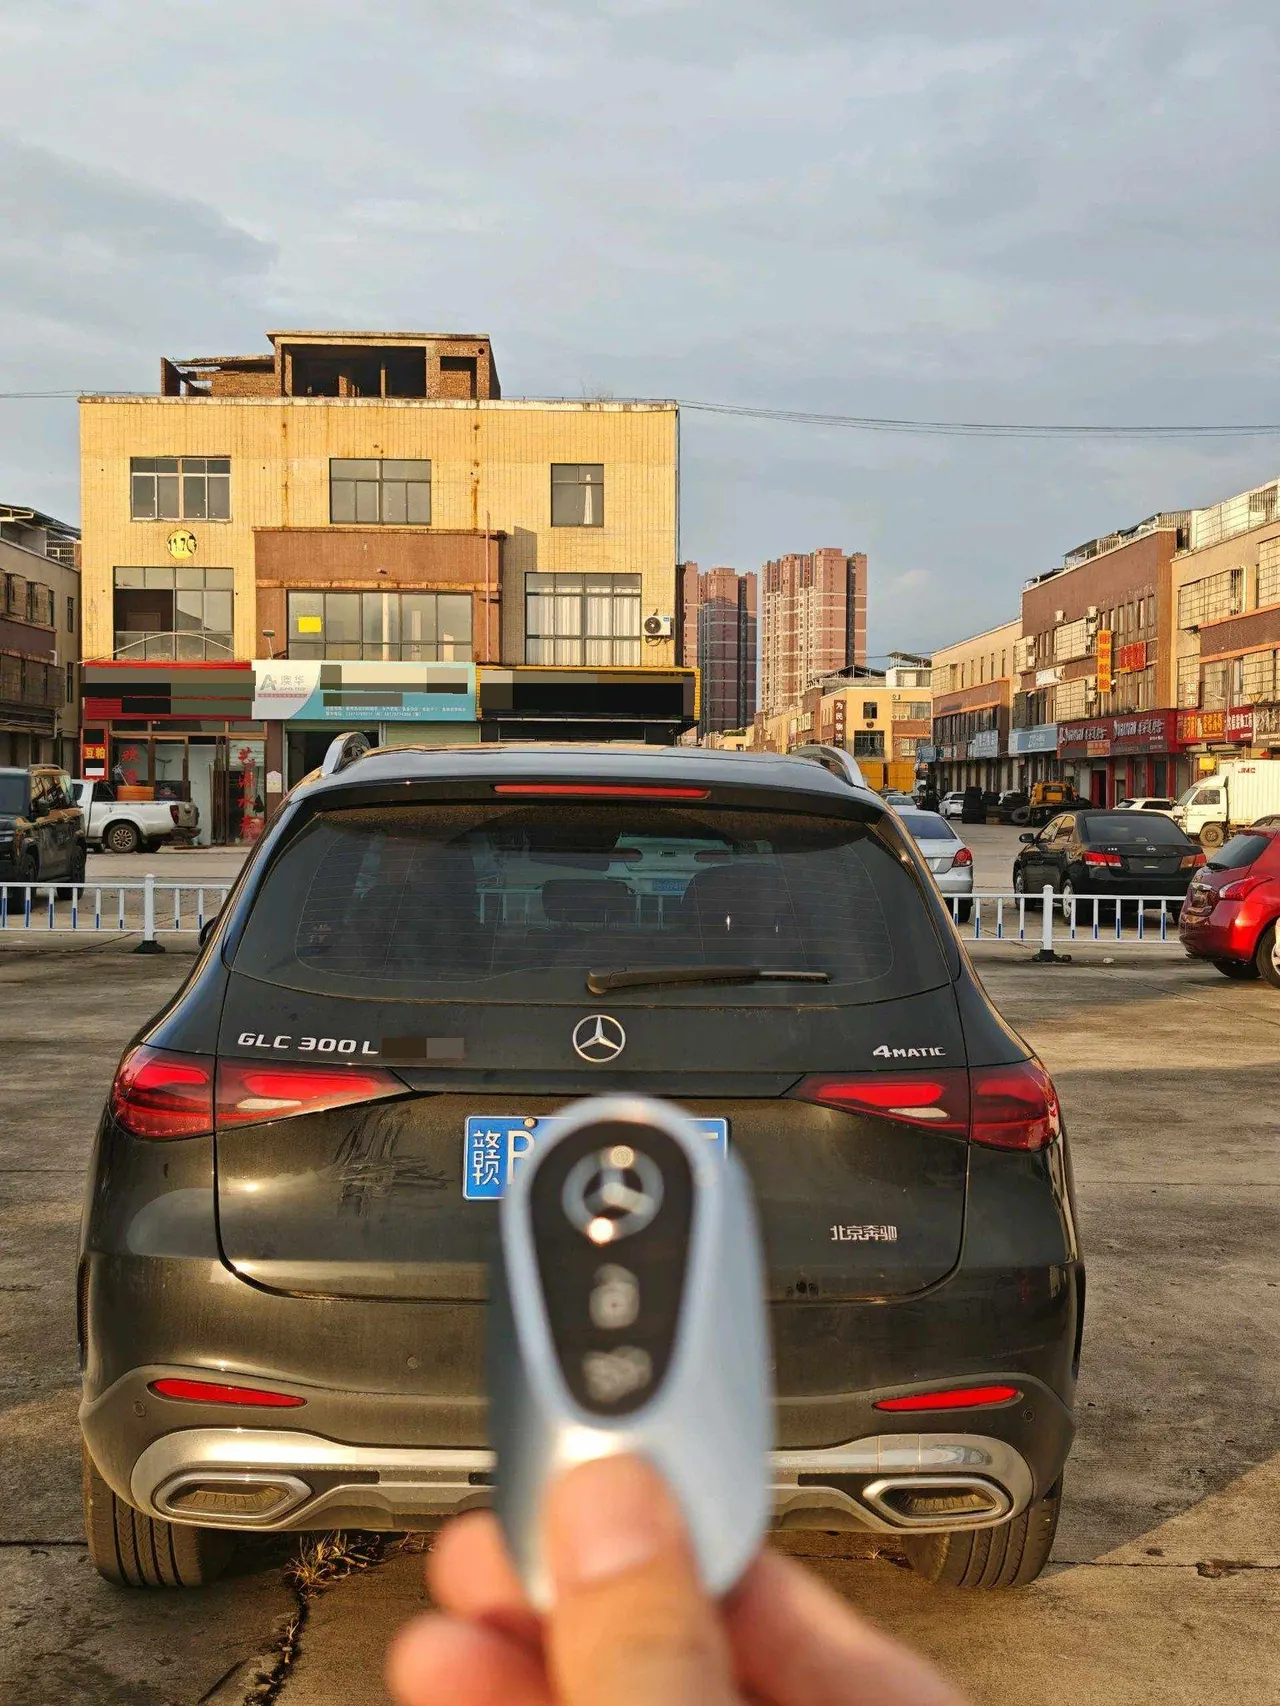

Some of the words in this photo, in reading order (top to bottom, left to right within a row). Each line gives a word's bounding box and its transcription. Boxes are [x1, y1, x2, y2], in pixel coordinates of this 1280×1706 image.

[237, 1032, 292, 1049] GLC
[297, 1037, 356, 1054] 300
[361, 1040, 380, 1055] L
[872, 1044, 946, 1058] 4MATIC
[830, 1224, 898, 1241] 北京奔驰
